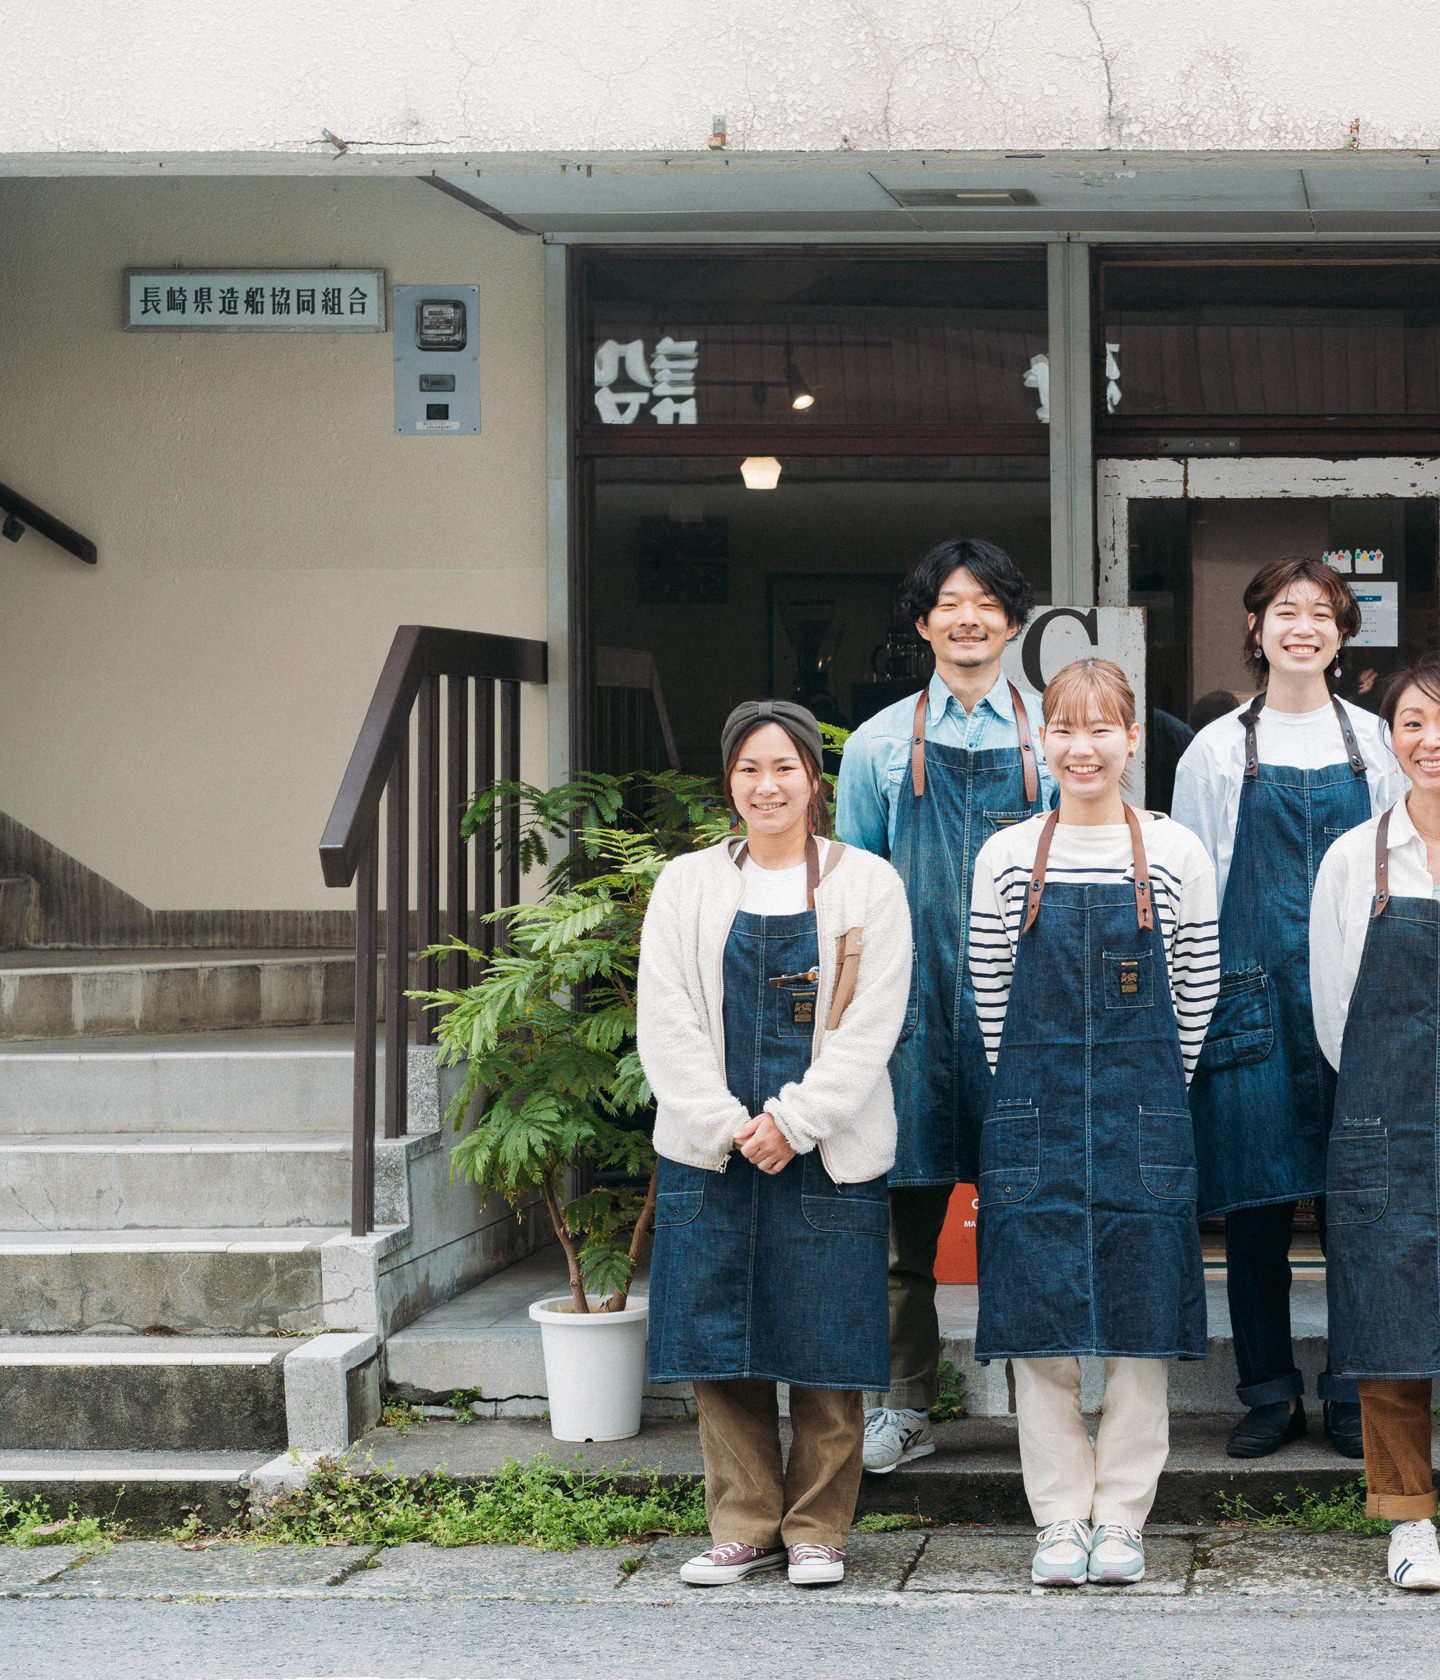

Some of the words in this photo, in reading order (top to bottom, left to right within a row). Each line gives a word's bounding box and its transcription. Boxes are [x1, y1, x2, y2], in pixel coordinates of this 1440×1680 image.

[140, 286, 368, 316] 長崎県造船協同組合
